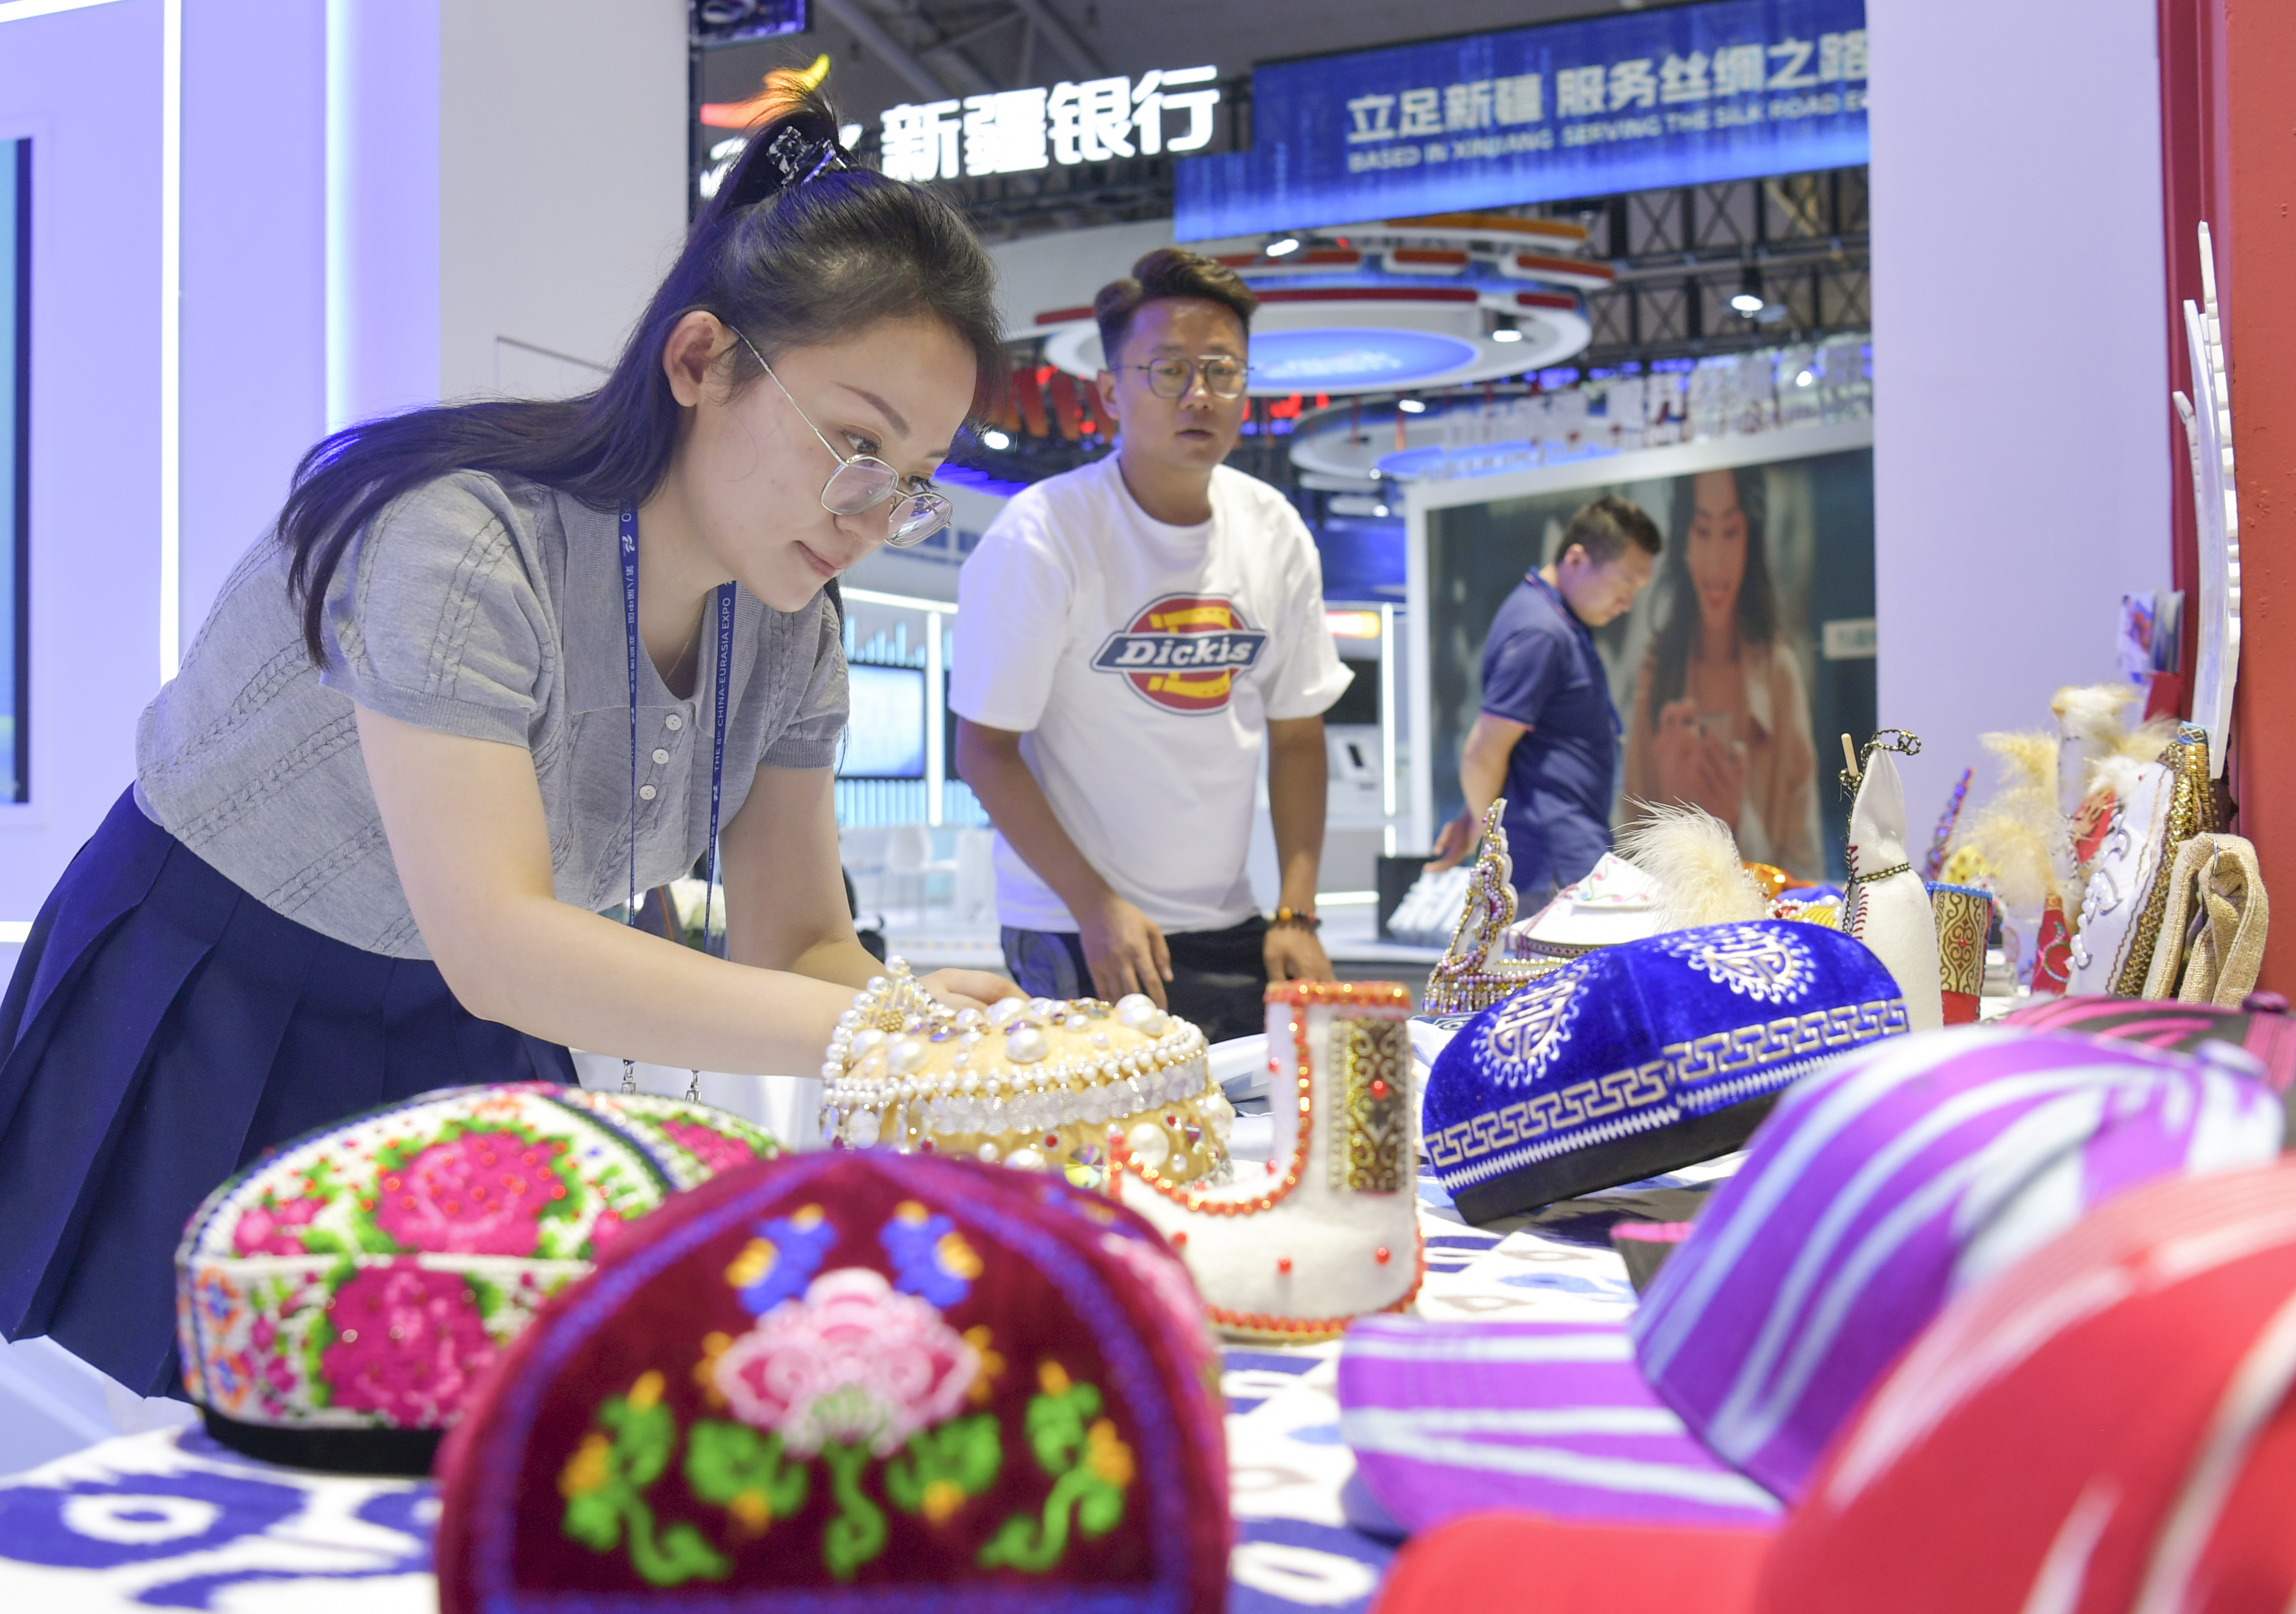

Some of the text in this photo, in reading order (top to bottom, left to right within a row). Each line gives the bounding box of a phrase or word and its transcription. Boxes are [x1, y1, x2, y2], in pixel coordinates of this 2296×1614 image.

[880, 64, 1221, 183] 新疆银行
[1347, 73, 1544, 144] 立足新疆
[1348, 145, 1422, 173] BASED
[1424, 142, 1450, 163] IN
[1561, 115, 1663, 147] SERVING
[1665, 108, 1710, 133] THE
[721, 597, 731, 629] EXPO
[718, 632, 730, 727] CHINA-EURASIA
[1115, 637, 1253, 665] Dickis
